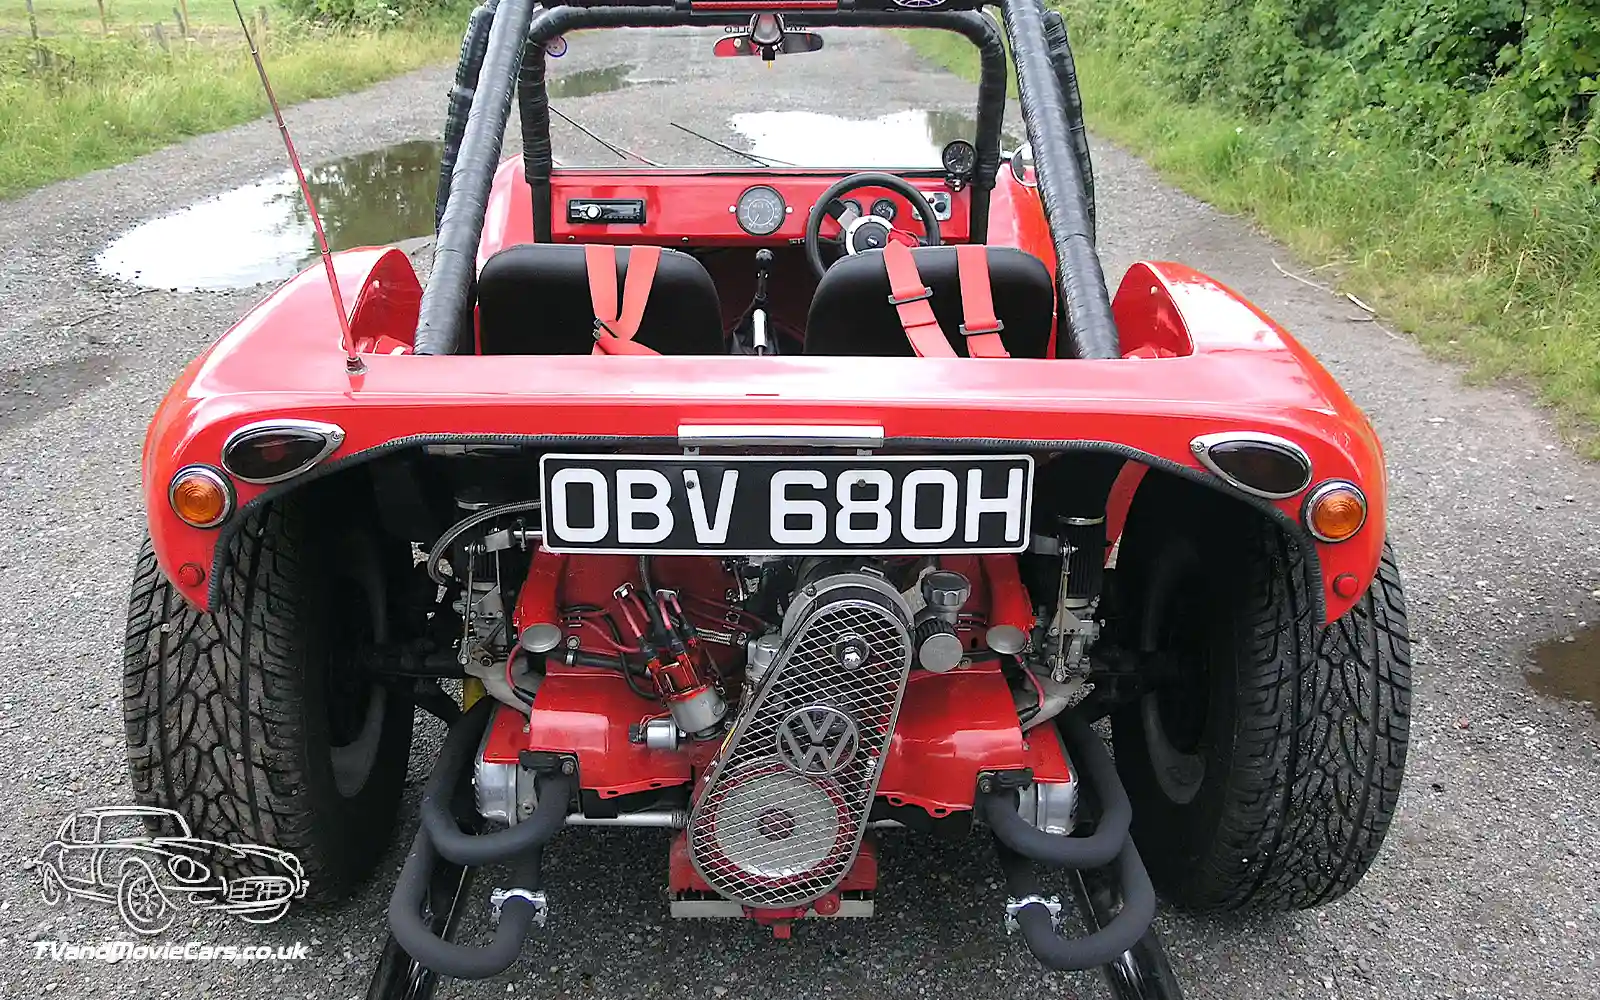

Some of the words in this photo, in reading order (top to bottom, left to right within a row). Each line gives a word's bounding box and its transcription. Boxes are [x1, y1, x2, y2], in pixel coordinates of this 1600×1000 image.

[550, 467, 740, 544] OBV
[769, 468, 1024, 544] 680H
[776, 705, 858, 776] VW
